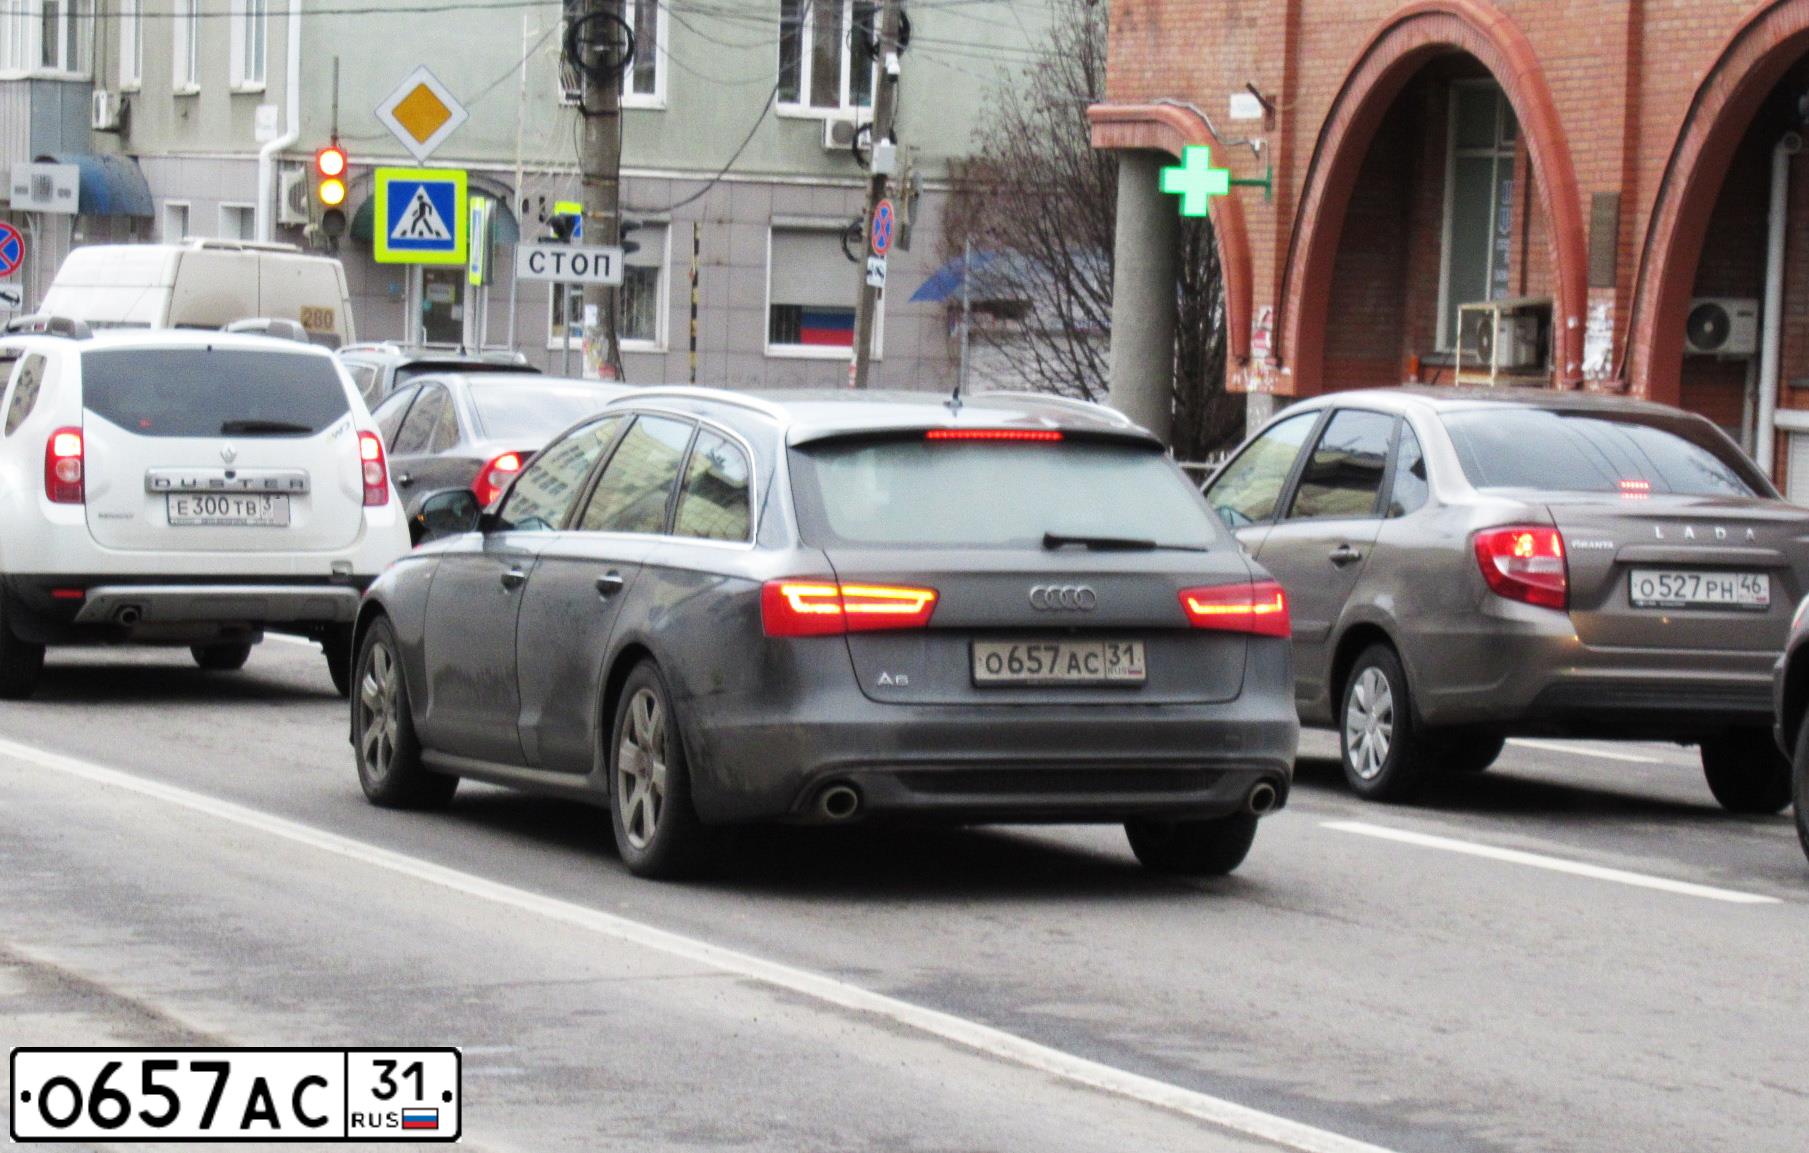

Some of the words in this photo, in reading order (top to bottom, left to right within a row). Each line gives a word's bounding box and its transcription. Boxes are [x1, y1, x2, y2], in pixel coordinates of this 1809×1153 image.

[529, 251, 610, 277] СТОП
[154, 478, 304, 489] DUSTER
[1655, 526, 1755, 541] LADA
[1741, 574, 1762, 594] 46
[1107, 644, 1135, 667] 31
[877, 671, 909, 687] A6
